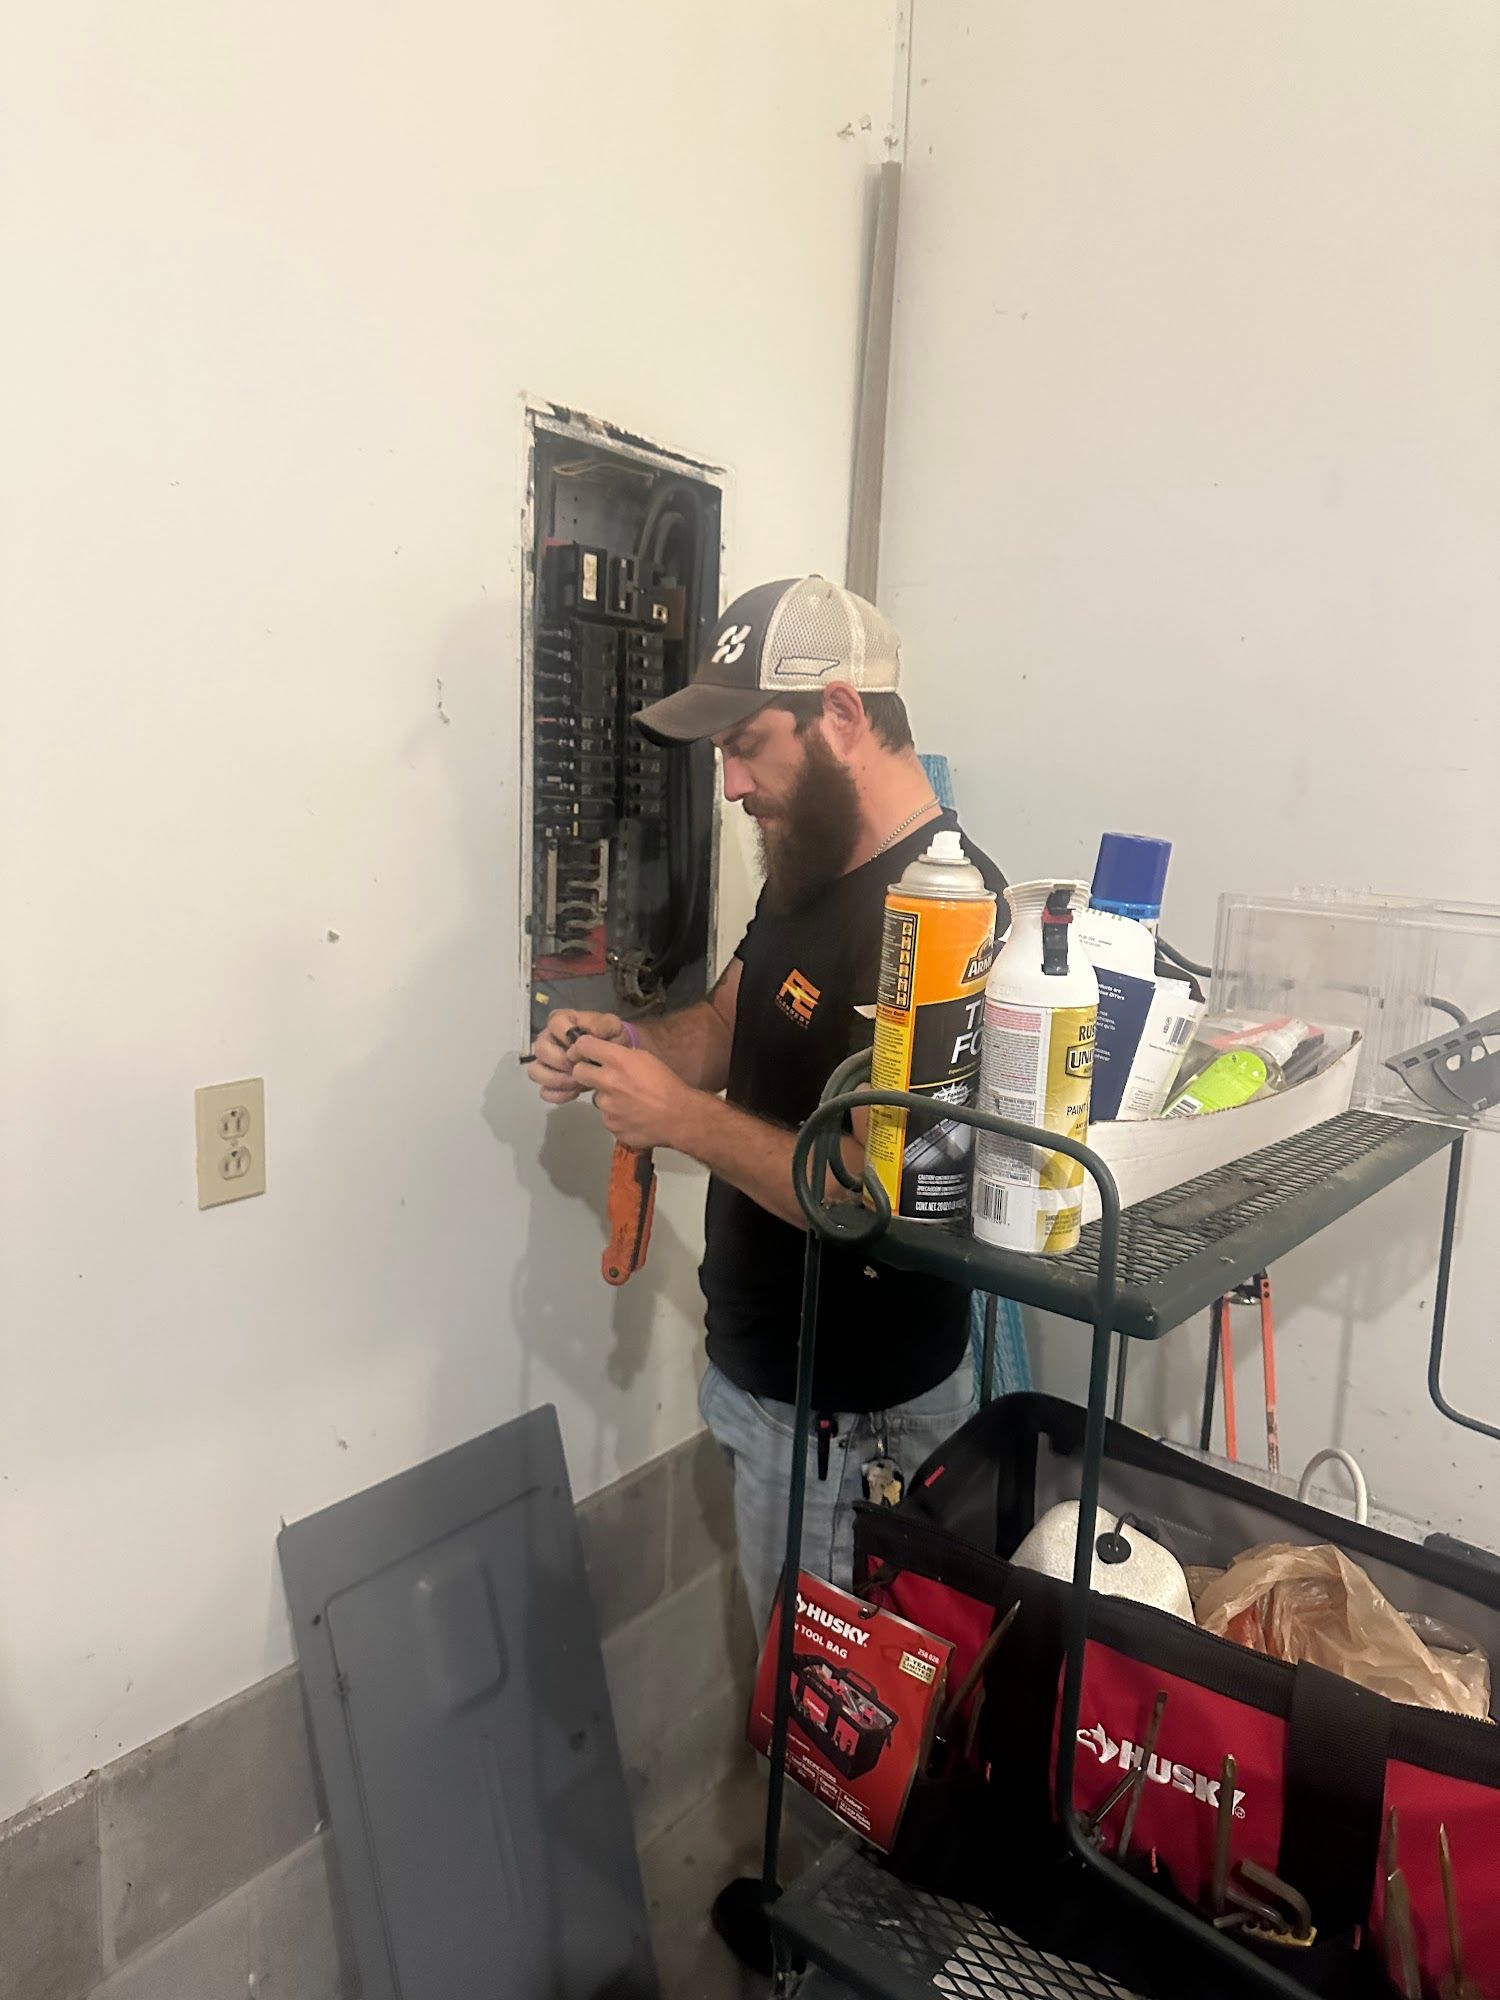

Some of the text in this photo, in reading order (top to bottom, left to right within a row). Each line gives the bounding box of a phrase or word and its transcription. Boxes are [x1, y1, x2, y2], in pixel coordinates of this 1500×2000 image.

[801, 1624, 825, 1647] TOOL
[826, 1640, 848, 1659] BAG
[806, 1602, 870, 1645] HUSKY
